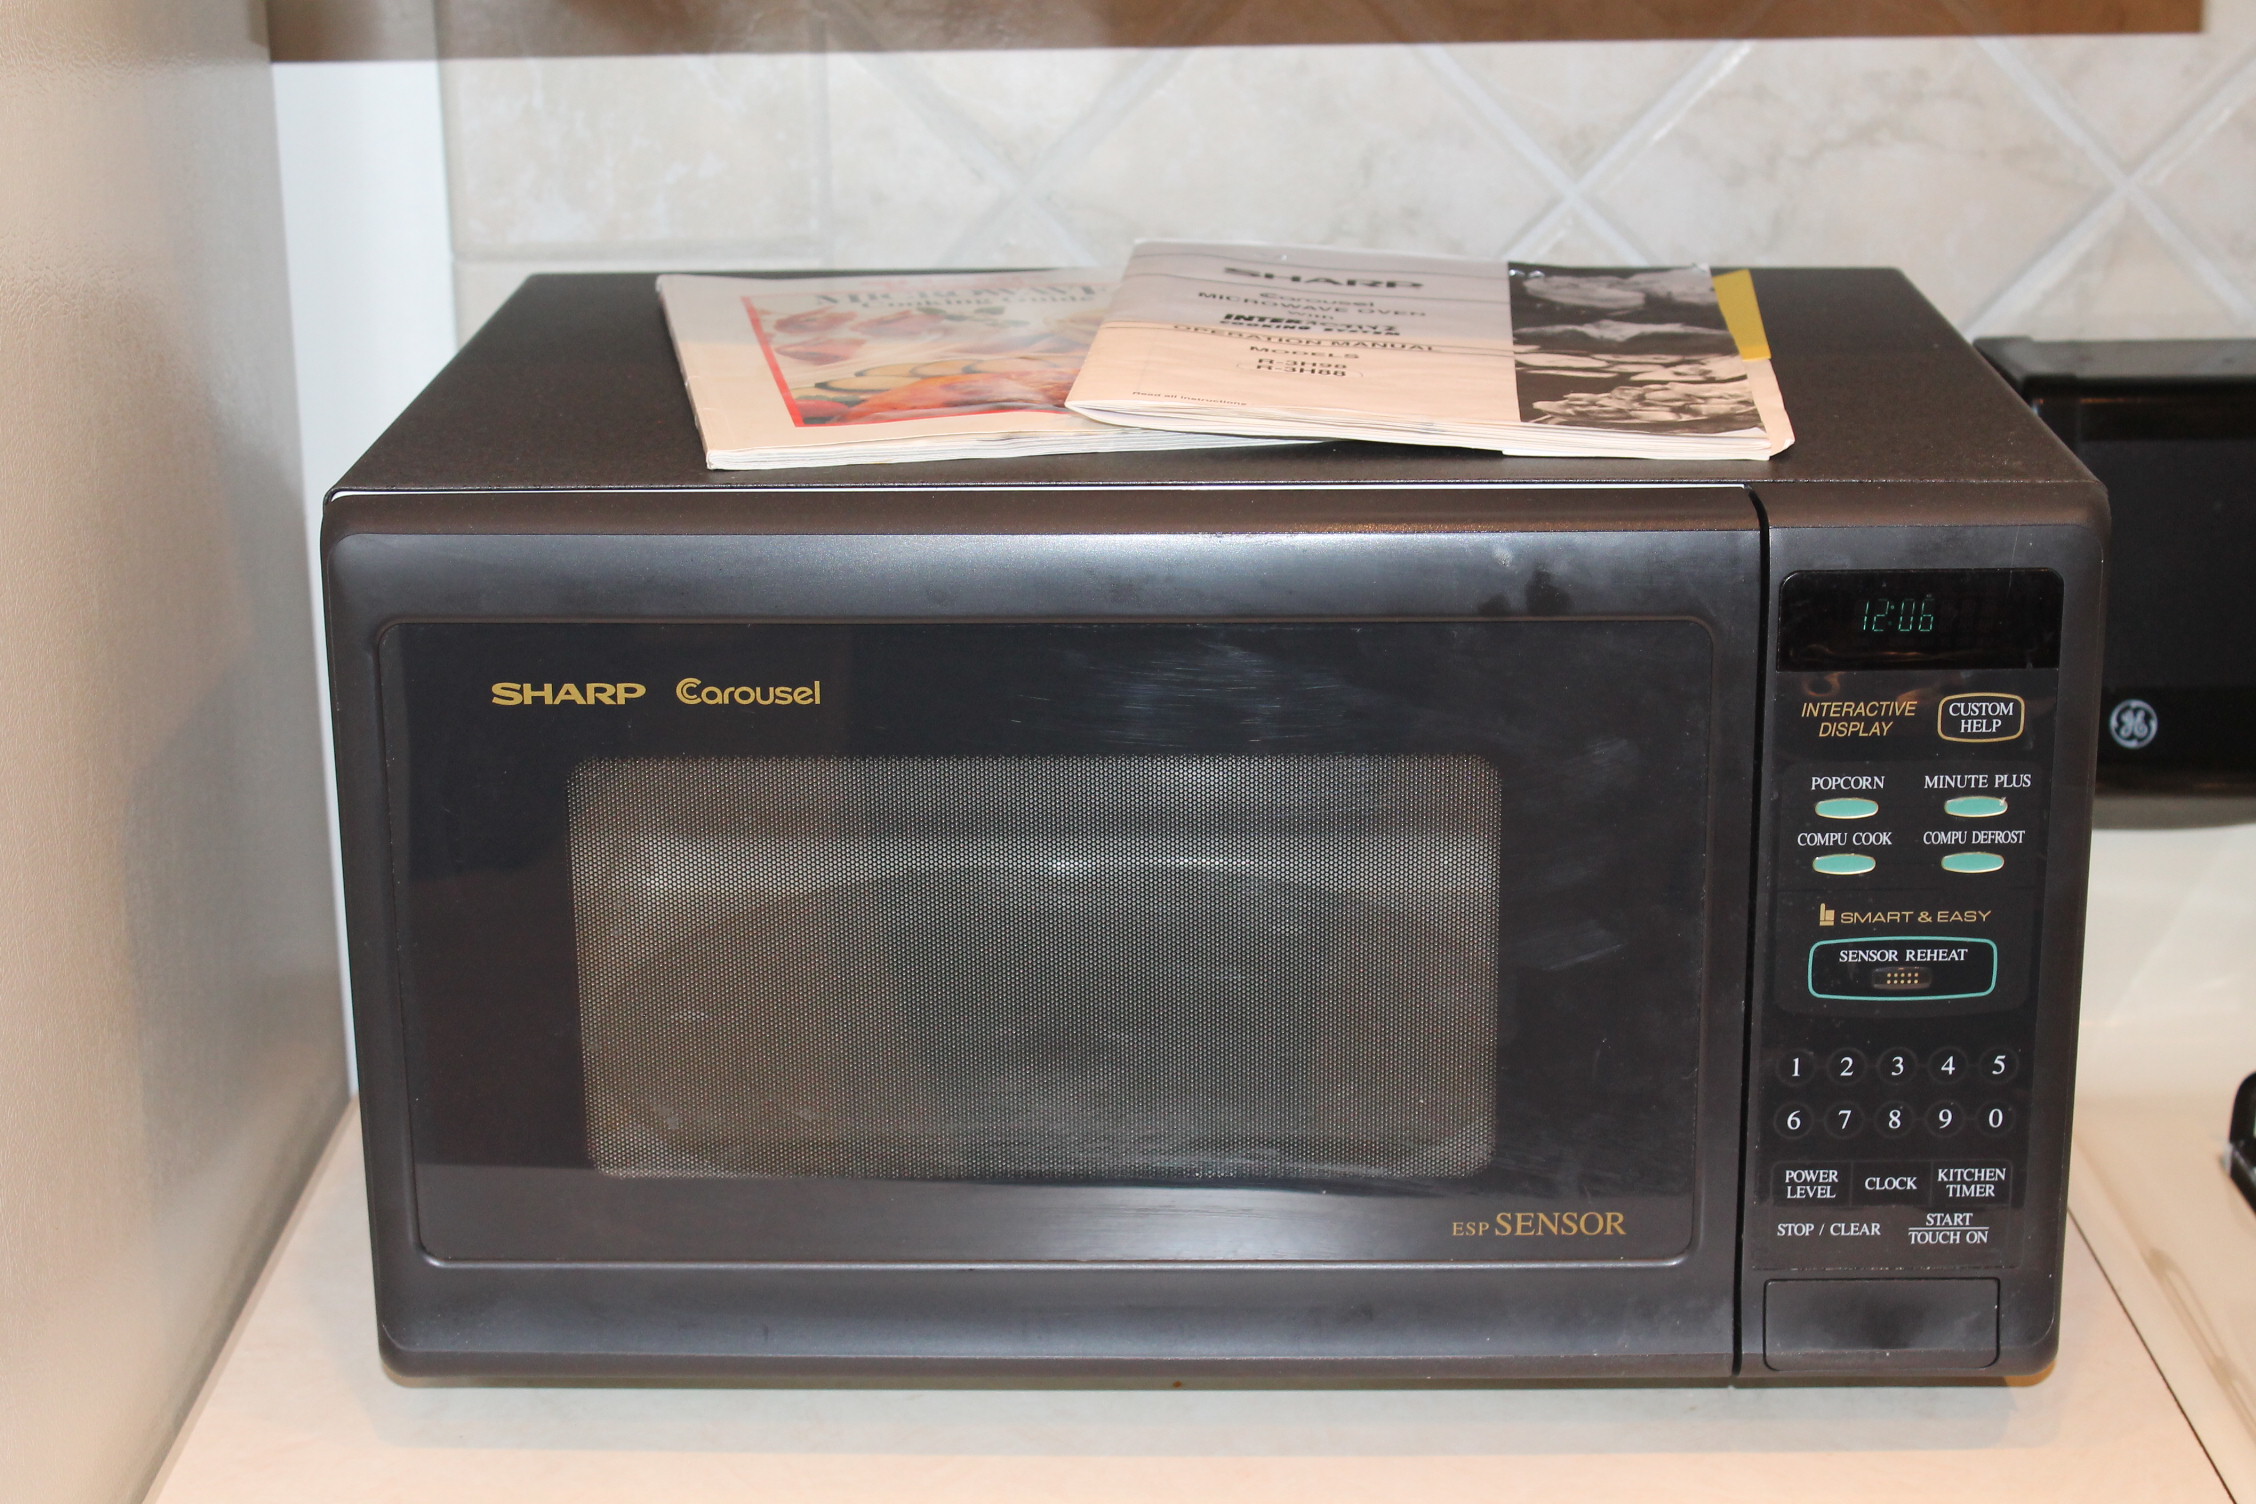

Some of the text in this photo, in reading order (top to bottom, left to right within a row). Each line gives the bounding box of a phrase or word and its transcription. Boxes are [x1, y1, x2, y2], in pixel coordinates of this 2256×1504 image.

[1223, 266, 1424, 289] SHARP
[1197, 290, 1427, 317] MICROWAVE OVEN
[1258, 291, 1376, 308] Carousel
[1218, 320, 1401, 337] COOKING SYSTEM
[1222, 313, 1400, 332] INTERACTIVE
[1173, 324, 1437, 352] OPERATION MANUAL
[1249, 345, 1361, 360] MODELS
[1862, 598, 1935, 632] 12:06
[491, 677, 821, 706] SHARP Carousel
[1801, 700, 1918, 717] INTERACTIVE
[1948, 702, 2014, 717] CUSTOM
[1818, 721, 1894, 737] DISPLAY
[1960, 718, 2002, 733] HELP
[1811, 775, 1885, 791] POPCORN
[1923, 773, 2032, 789] MINUTE PLUS
[1797, 831, 1893, 847] COMPU COOK
[1923, 830, 2026, 845] COMPU DEFROST
[1840, 910, 1992, 924] SMART & EASY
[1839, 948, 1969, 963] SENSOR REHEAT
[1792, 1055, 2006, 1077] 1 2 3 4 5
[1786, 1108, 2003, 1130] 6 7 8 9 0
[1785, 1169, 1839, 1183] POWER
[1864, 1176, 1917, 1190] CLOCK
[1937, 1168, 2006, 1182] KITCHEN
[1786, 1185, 1836, 1199] LEVEL
[1946, 1184, 1995, 1197] TIMER
[1452, 1211, 1626, 1236] ESP SENSOR
[1925, 1212, 1974, 1226] START
[1777, 1223, 1815, 1237] STOP
[1829, 1222, 1881, 1236] CLEAR
[1908, 1230, 1989, 1245] TOUCH ON
